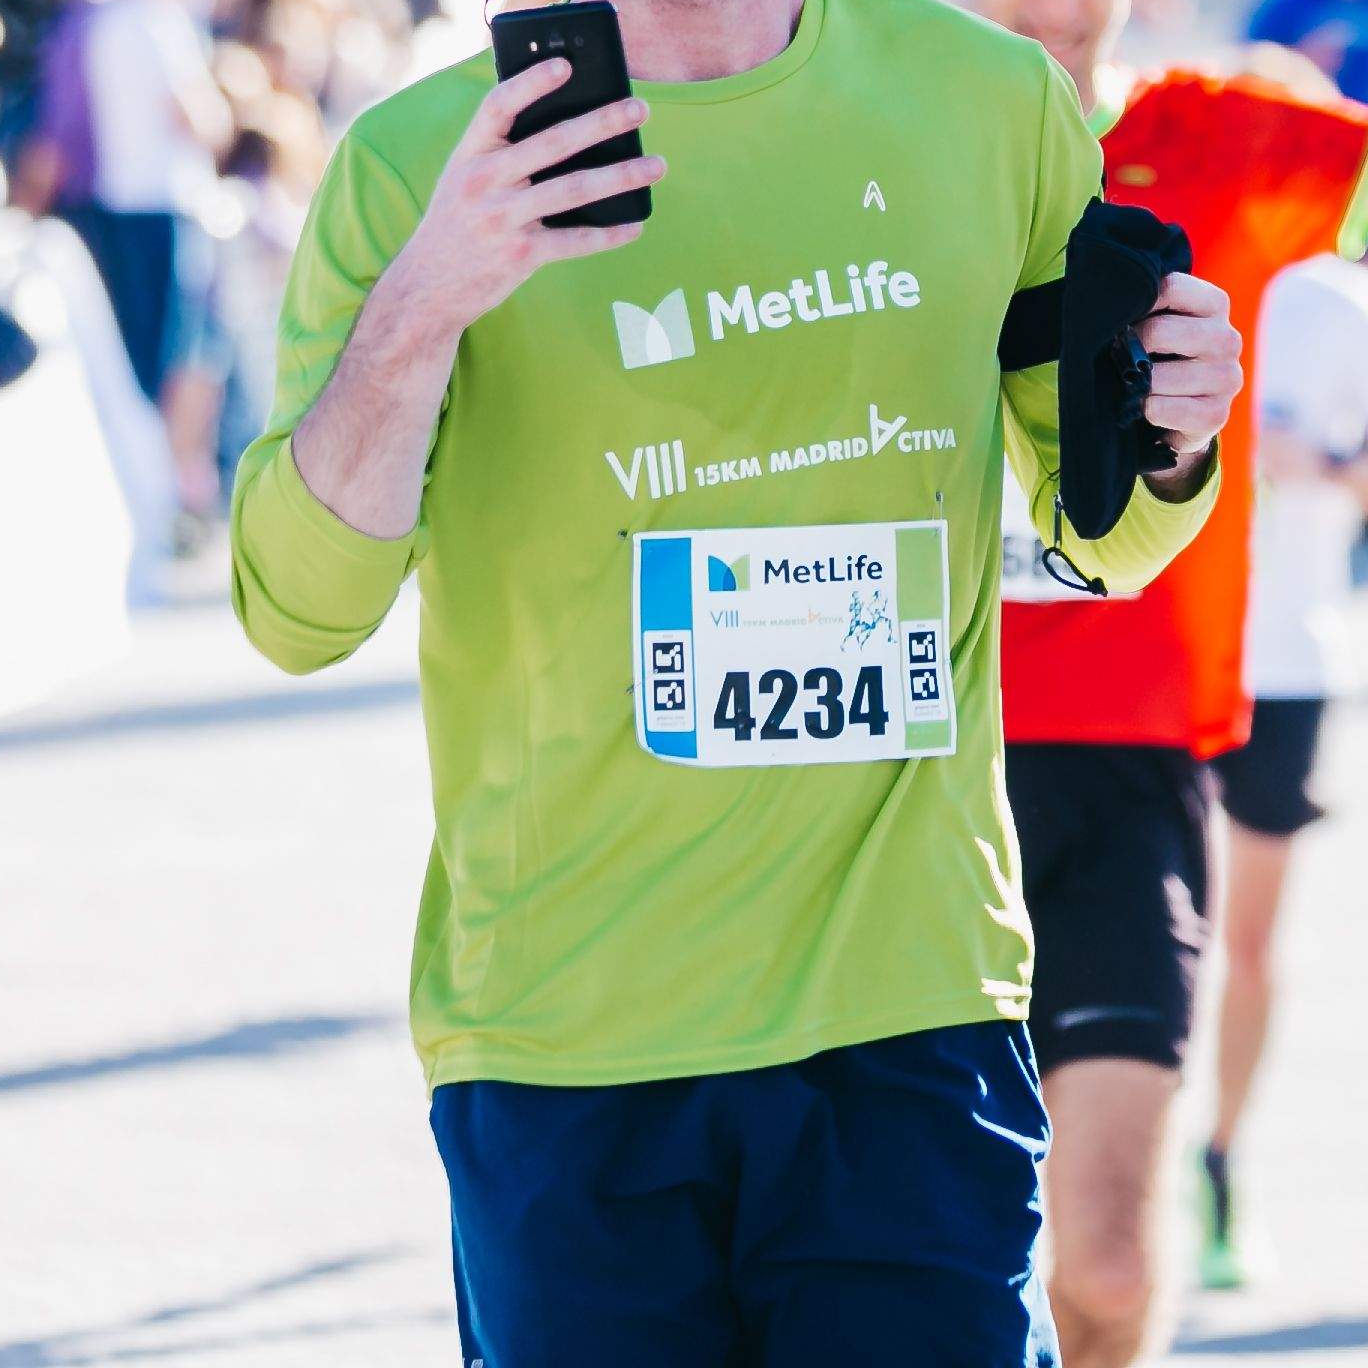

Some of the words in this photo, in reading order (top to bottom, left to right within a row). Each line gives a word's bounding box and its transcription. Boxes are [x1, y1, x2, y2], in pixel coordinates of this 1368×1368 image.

[706, 259, 921, 341] MetLife
[605, 439, 687, 501] VIII
[694, 456, 762, 488] 15KM
[764, 554, 883, 585] MetLife
[710, 610, 739, 628] VIII
[713, 665, 889, 741] 4234
